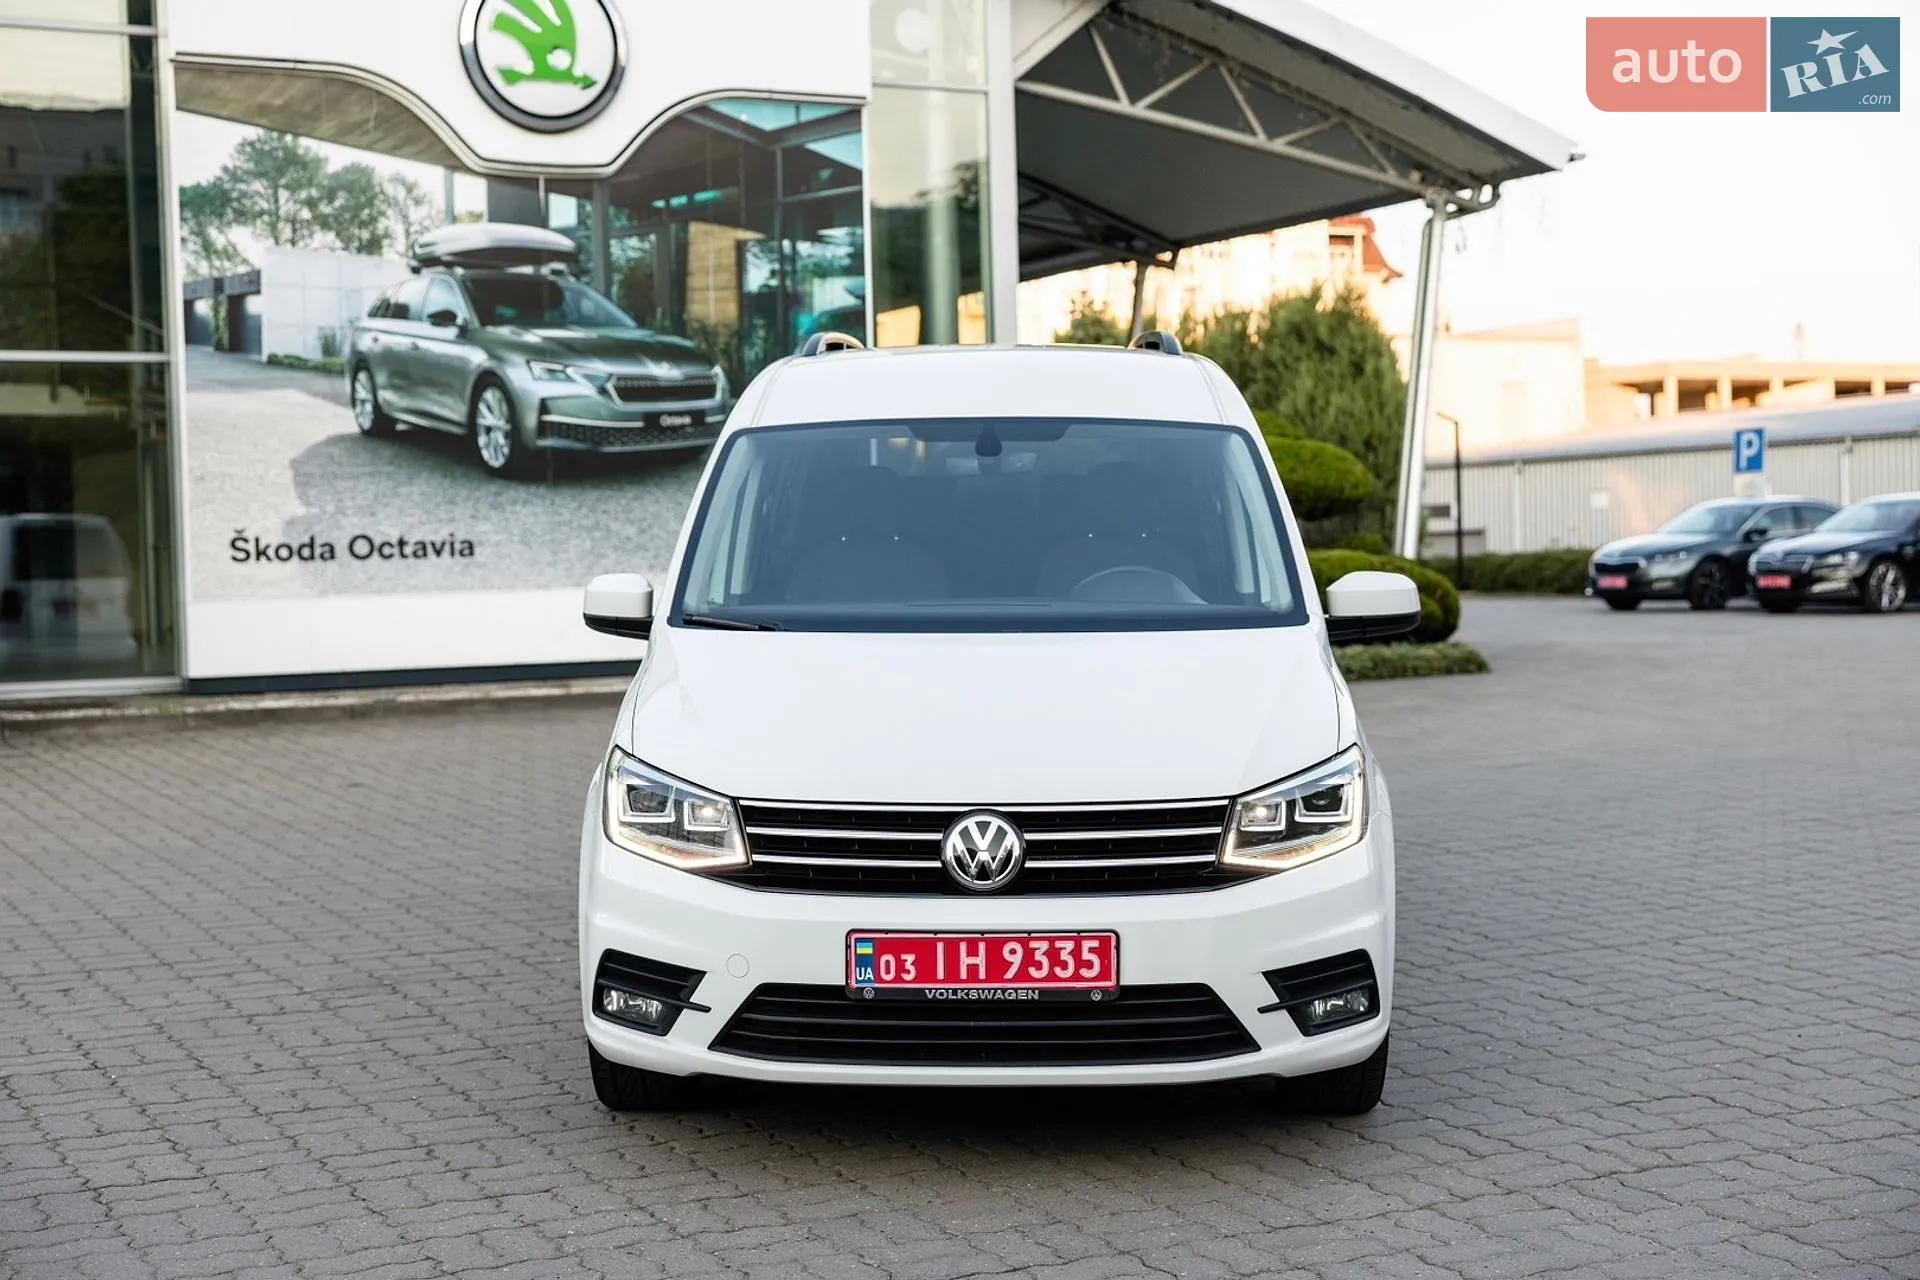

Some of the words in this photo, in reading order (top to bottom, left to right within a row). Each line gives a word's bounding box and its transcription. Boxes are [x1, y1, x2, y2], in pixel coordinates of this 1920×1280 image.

[1740, 431, 1760, 470] P
[230, 529, 336, 562] Škoda
[348, 533, 475, 560] Octavia
[856, 967, 874, 981] UA
[879, 953, 917, 981] 03
[936, 941, 986, 980] IH
[1002, 941, 1100, 979] 9335
[925, 989, 1039, 1000] VOLKSWAGEN
